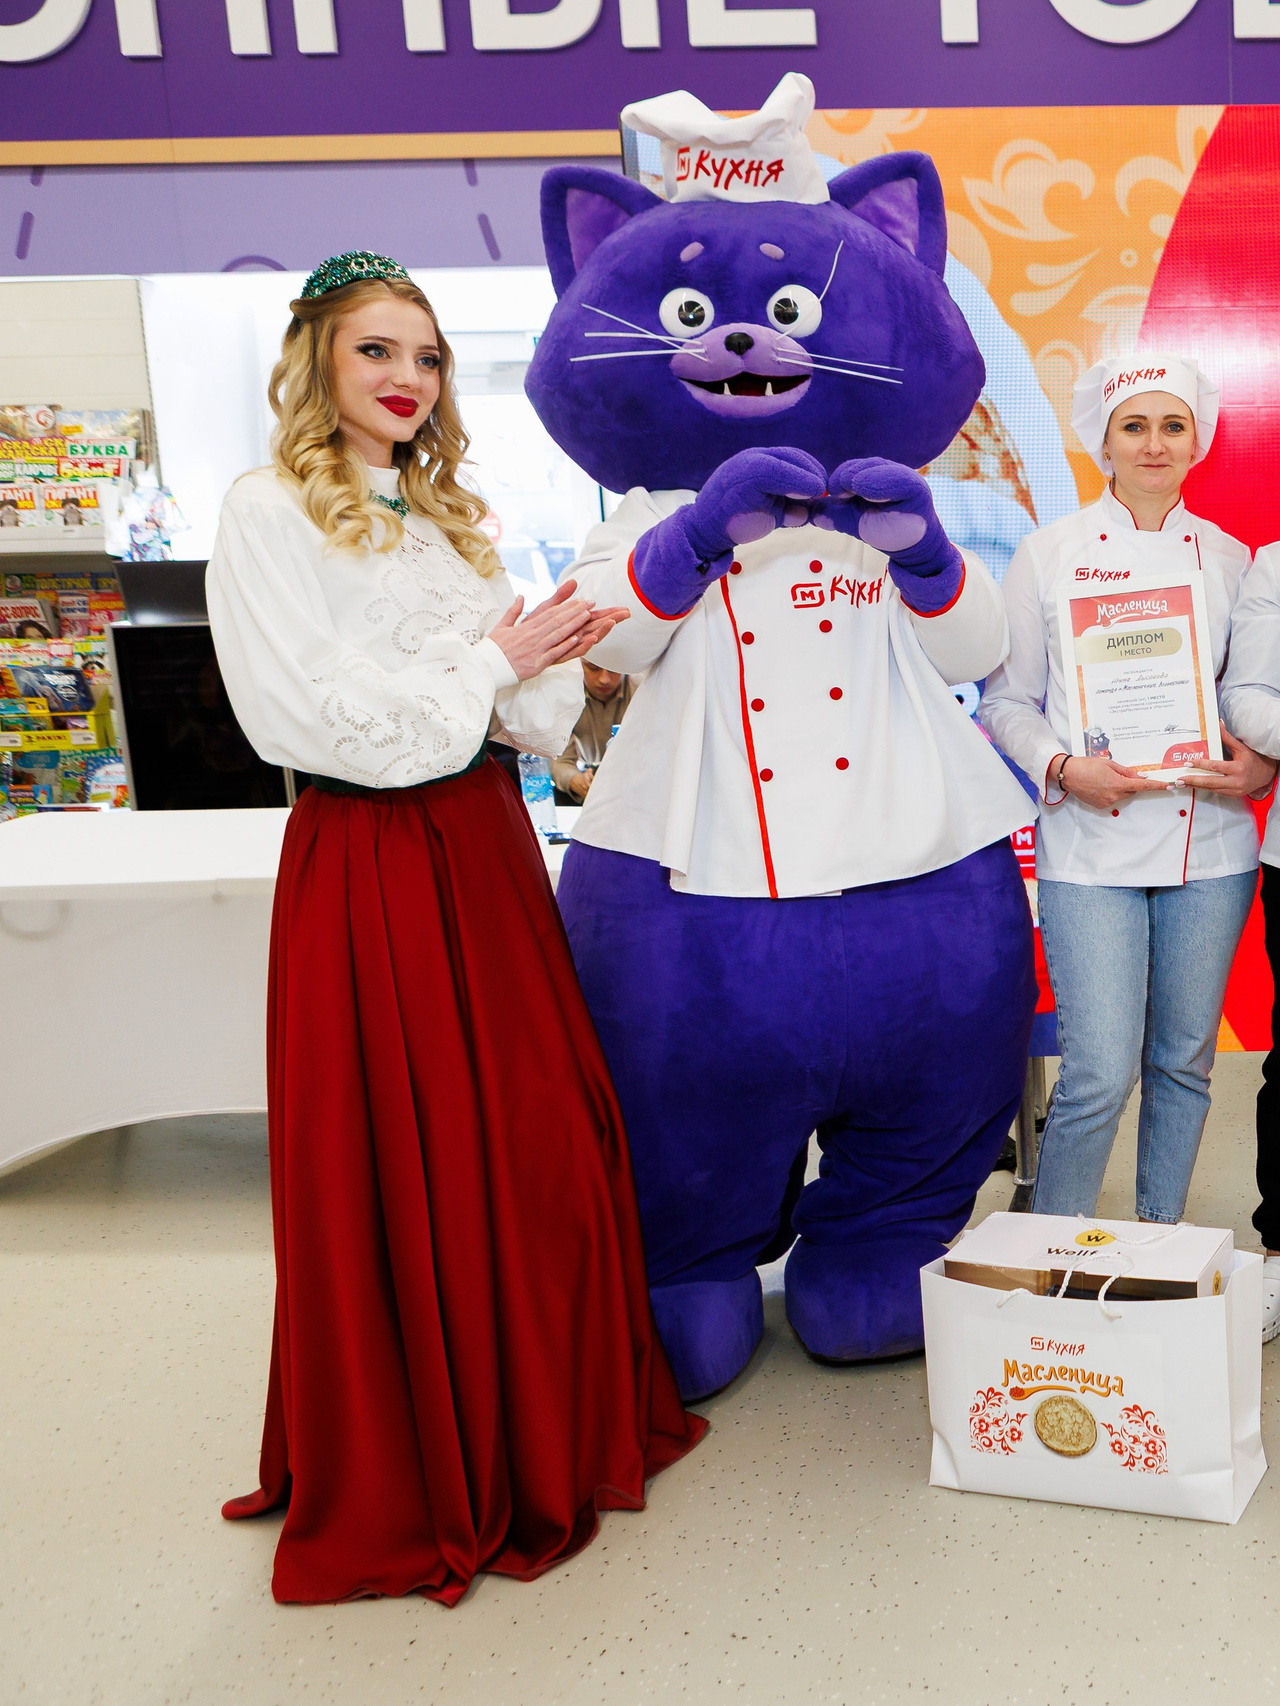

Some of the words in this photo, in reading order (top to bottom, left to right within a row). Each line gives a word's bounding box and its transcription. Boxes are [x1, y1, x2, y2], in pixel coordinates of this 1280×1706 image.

[694, 150, 785, 190] КУХНЯ
[1117, 368, 1167, 388] КУХНЯ
[69, 444, 129, 456] БУКВА
[1091, 568, 1131, 582] КУХНЯ
[830, 574, 882, 609] КУХН
[1096, 598, 1168, 623] Масленица
[1106, 632, 1165, 650] ДИПЛОМ
[1123, 647, 1152, 656] МЕСТО
[1047, 1338, 1085, 1356] КУХНЯ
[1001, 1358, 1125, 1397] Масленица
